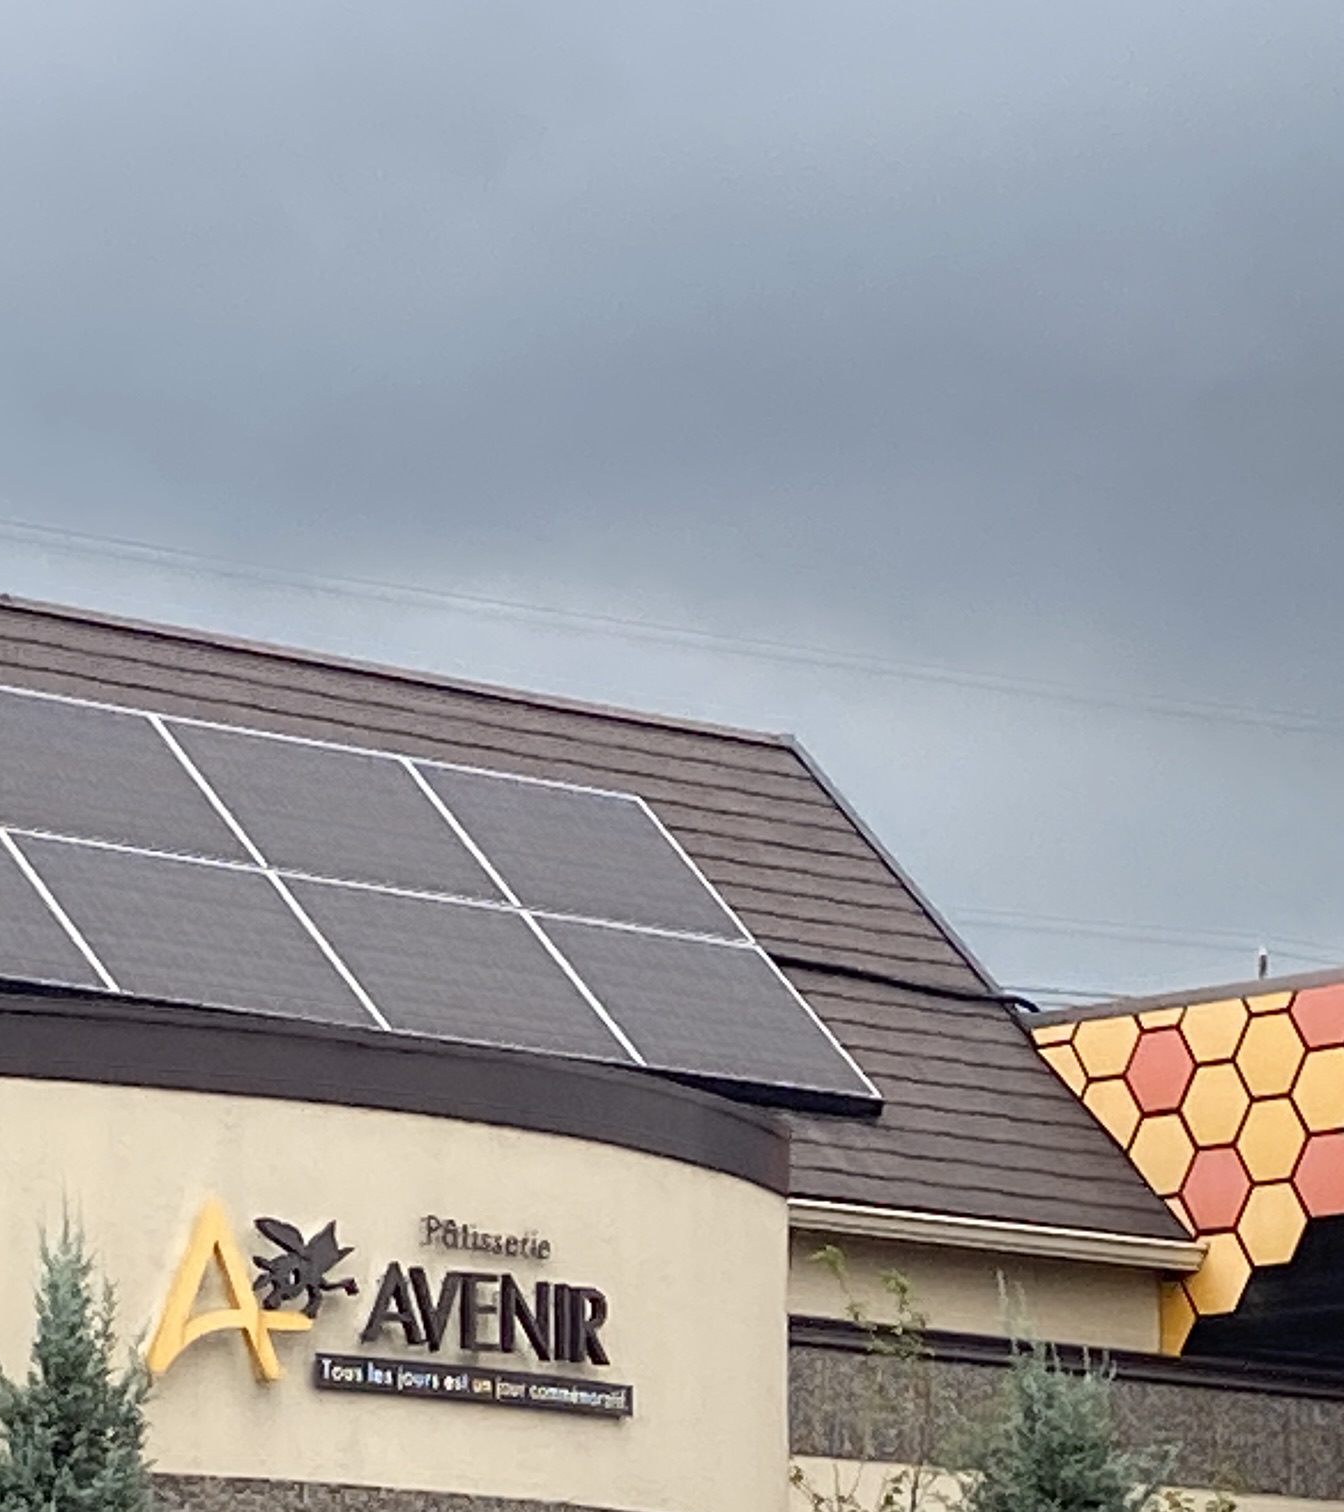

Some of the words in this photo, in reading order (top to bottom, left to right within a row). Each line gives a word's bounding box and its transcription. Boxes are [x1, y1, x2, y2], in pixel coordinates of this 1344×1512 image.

[420, 1215, 551, 1260] Pâtisserie
[360, 1262, 611, 1366] AVENIR
[321, 1358, 362, 1382] Tous
[367, 1362, 392, 1385] les
[397, 1365, 438, 1390] jours
[443, 1374, 468, 1392] est
